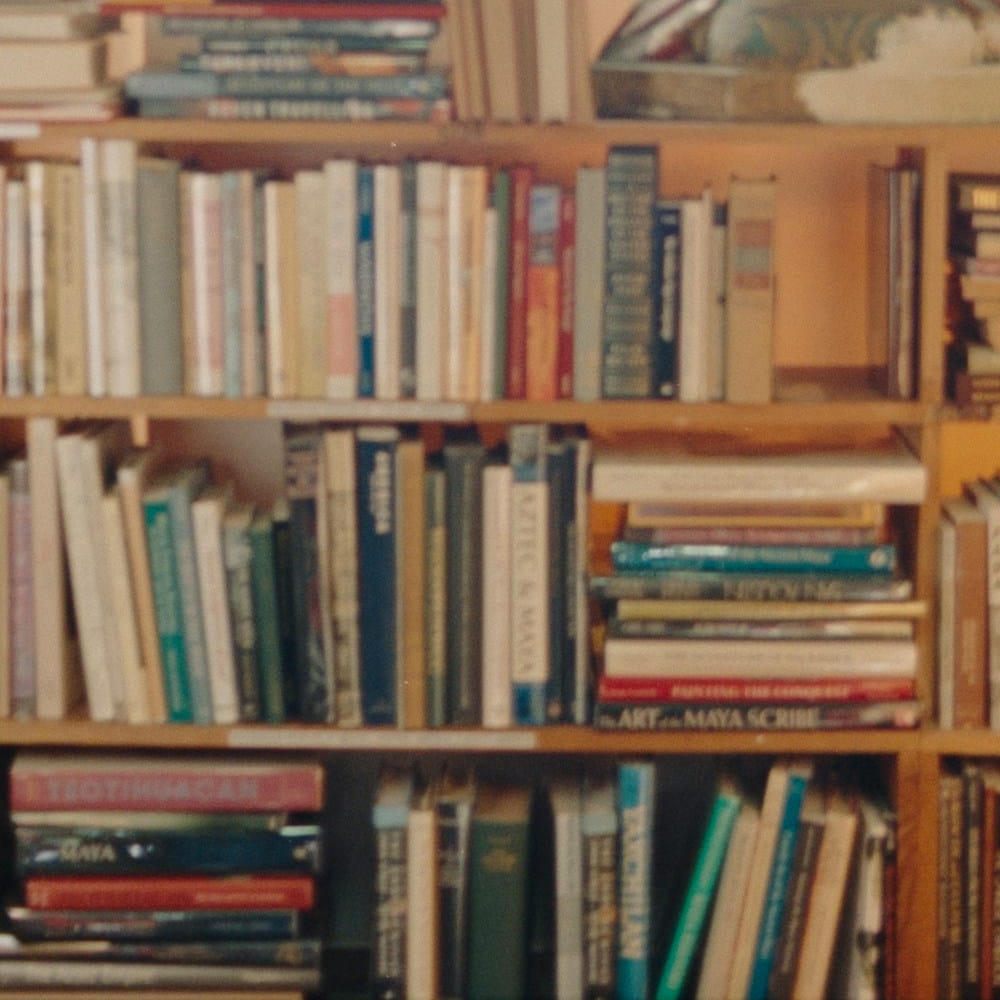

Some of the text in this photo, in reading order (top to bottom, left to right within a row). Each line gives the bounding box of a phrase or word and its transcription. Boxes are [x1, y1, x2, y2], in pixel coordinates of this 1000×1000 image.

[618, 708, 661, 728] ART
[684, 708, 742, 728] MAYA
[747, 708, 818, 728] SCRIBE
